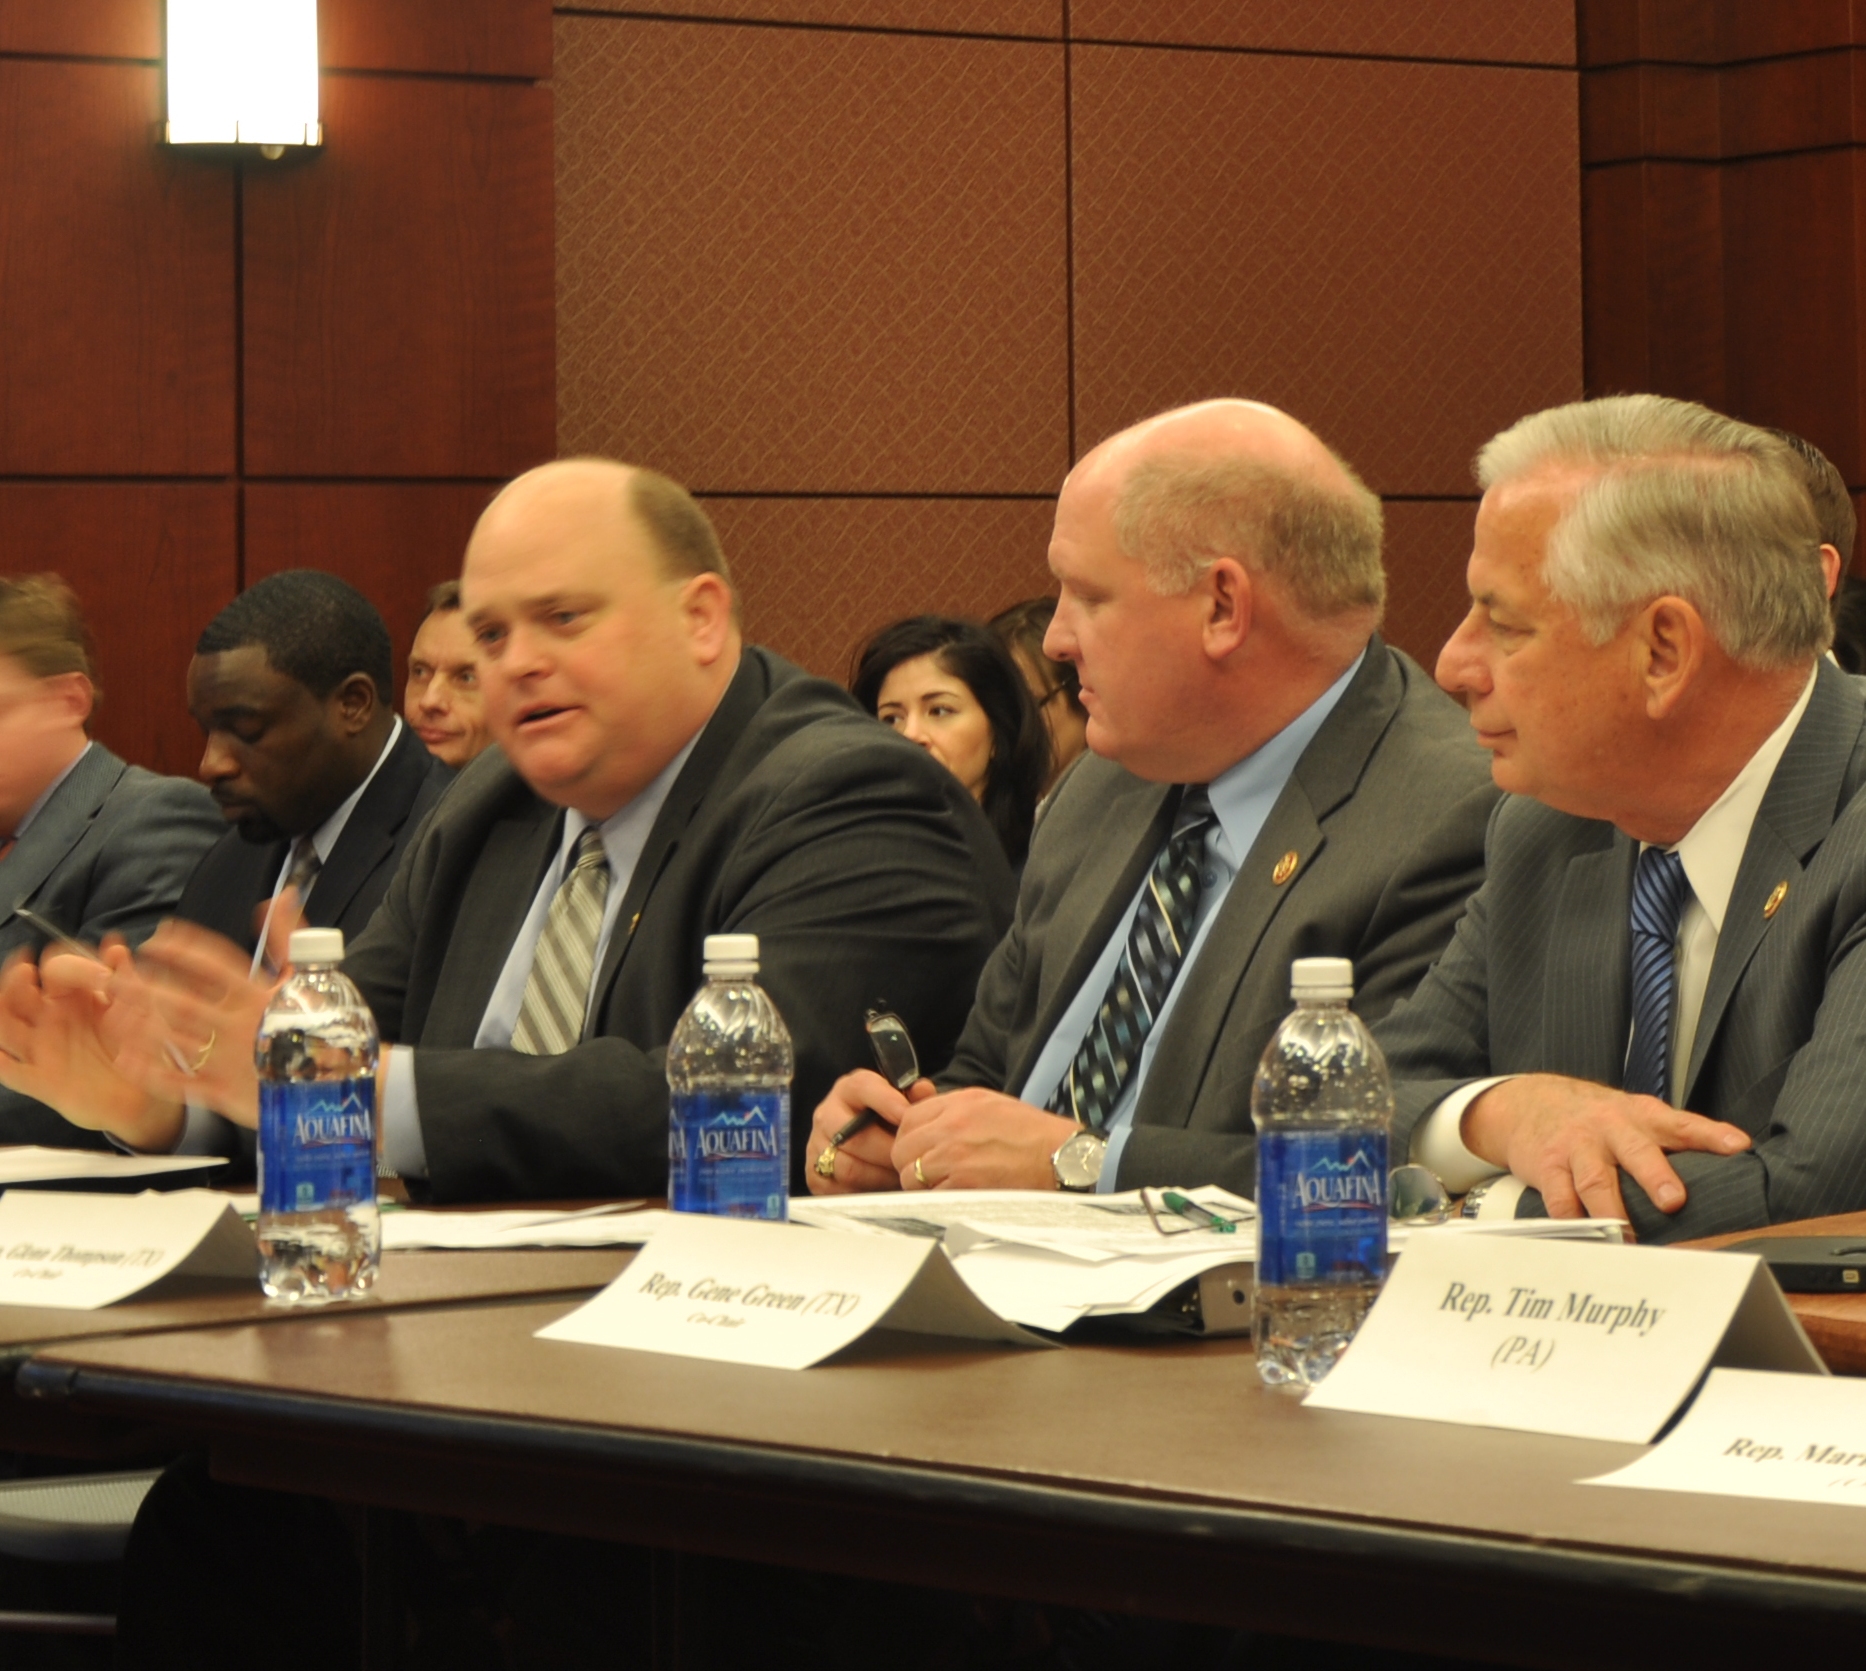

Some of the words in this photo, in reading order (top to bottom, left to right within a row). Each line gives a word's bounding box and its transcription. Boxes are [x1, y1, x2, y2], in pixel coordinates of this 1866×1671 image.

[293, 1109, 373, 1146] AQUAFINA
[695, 1124, 778, 1159] AQUAFINA
[1293, 1169, 1381, 1209] AQUAFINA
[51, 1244, 126, 1267] Thompson
[638, 1271, 682, 1301] Rep.
[687, 1277, 742, 1304] Gene
[741, 1283, 806, 1310] Green
[801, 1290, 861, 1318] (TX)
[1439, 1282, 1493, 1321] Rep.
[1503, 1287, 1554, 1319] Tim
[1556, 1292, 1666, 1337] Murphy
[1491, 1335, 1555, 1374] (PA)
[1723, 1438, 1784, 1463] Rep.
